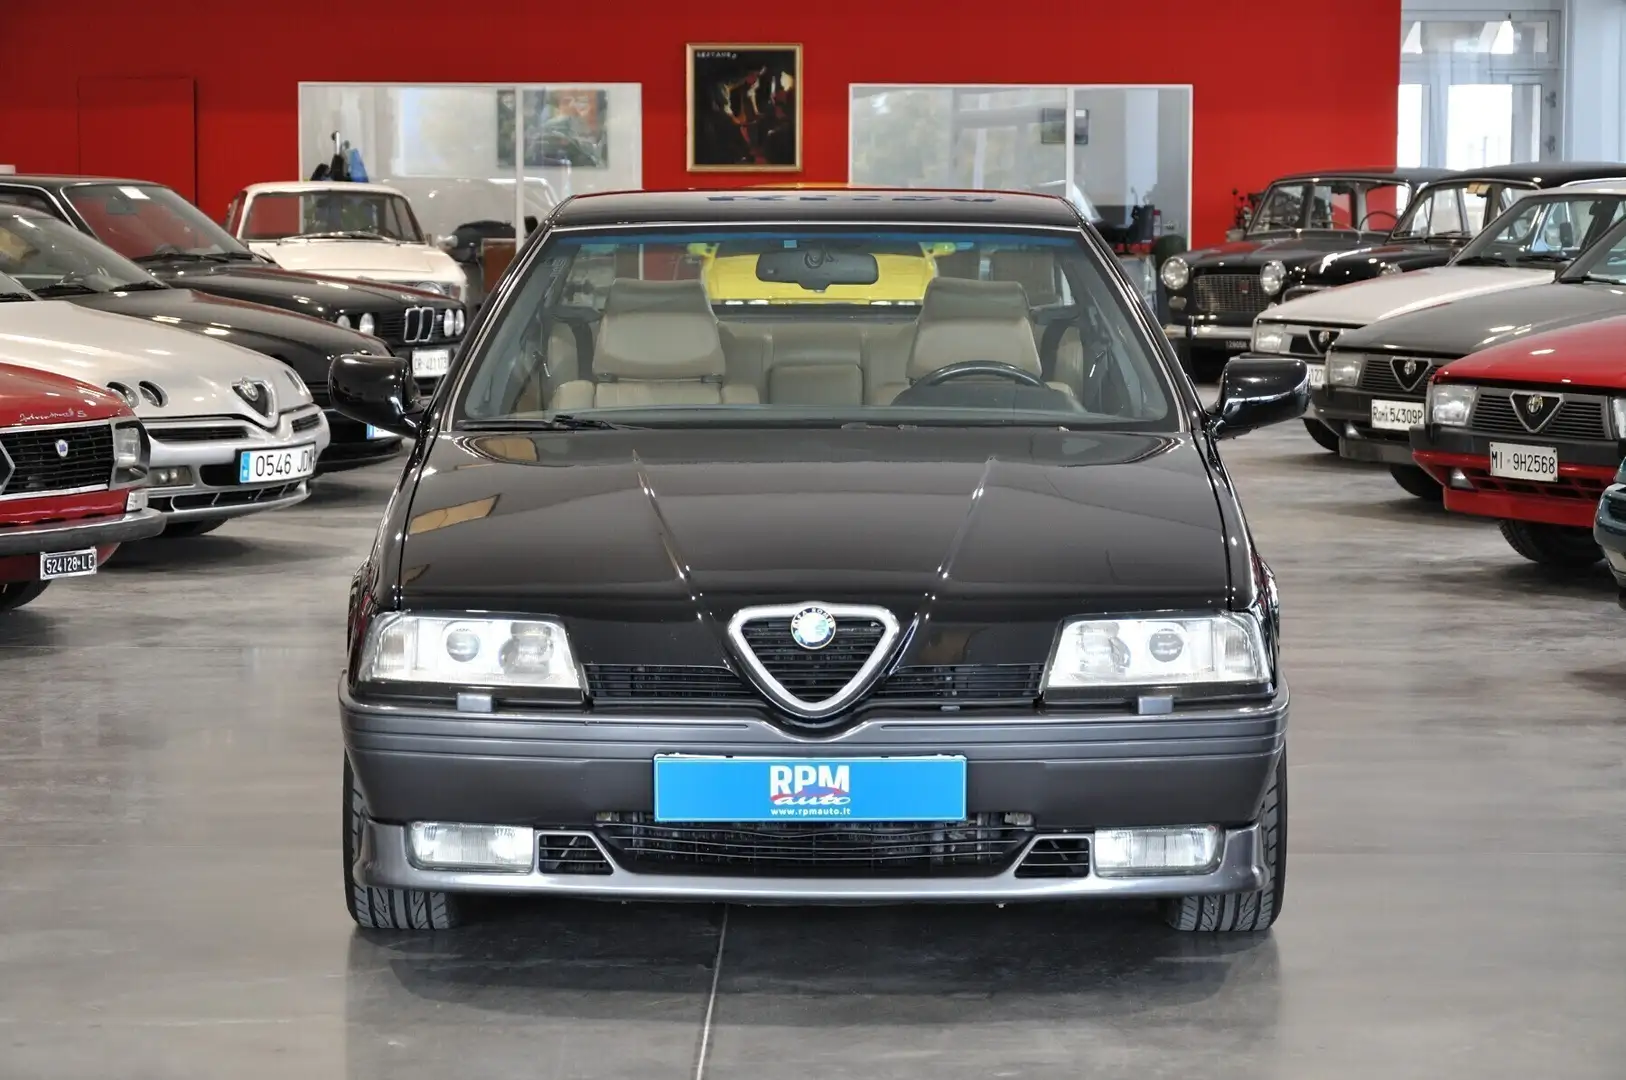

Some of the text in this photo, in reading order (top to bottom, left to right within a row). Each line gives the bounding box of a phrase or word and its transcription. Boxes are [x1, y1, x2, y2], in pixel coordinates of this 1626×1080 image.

[1390, 408, 1423, 424] 54309P
[256, 453, 291, 477] 0546
[1513, 453, 1555, 474] 9H2568
[769, 765, 849, 797] RPM
[773, 793, 851, 805] auto
[770, 807, 851, 816] www.rpmauto.it
